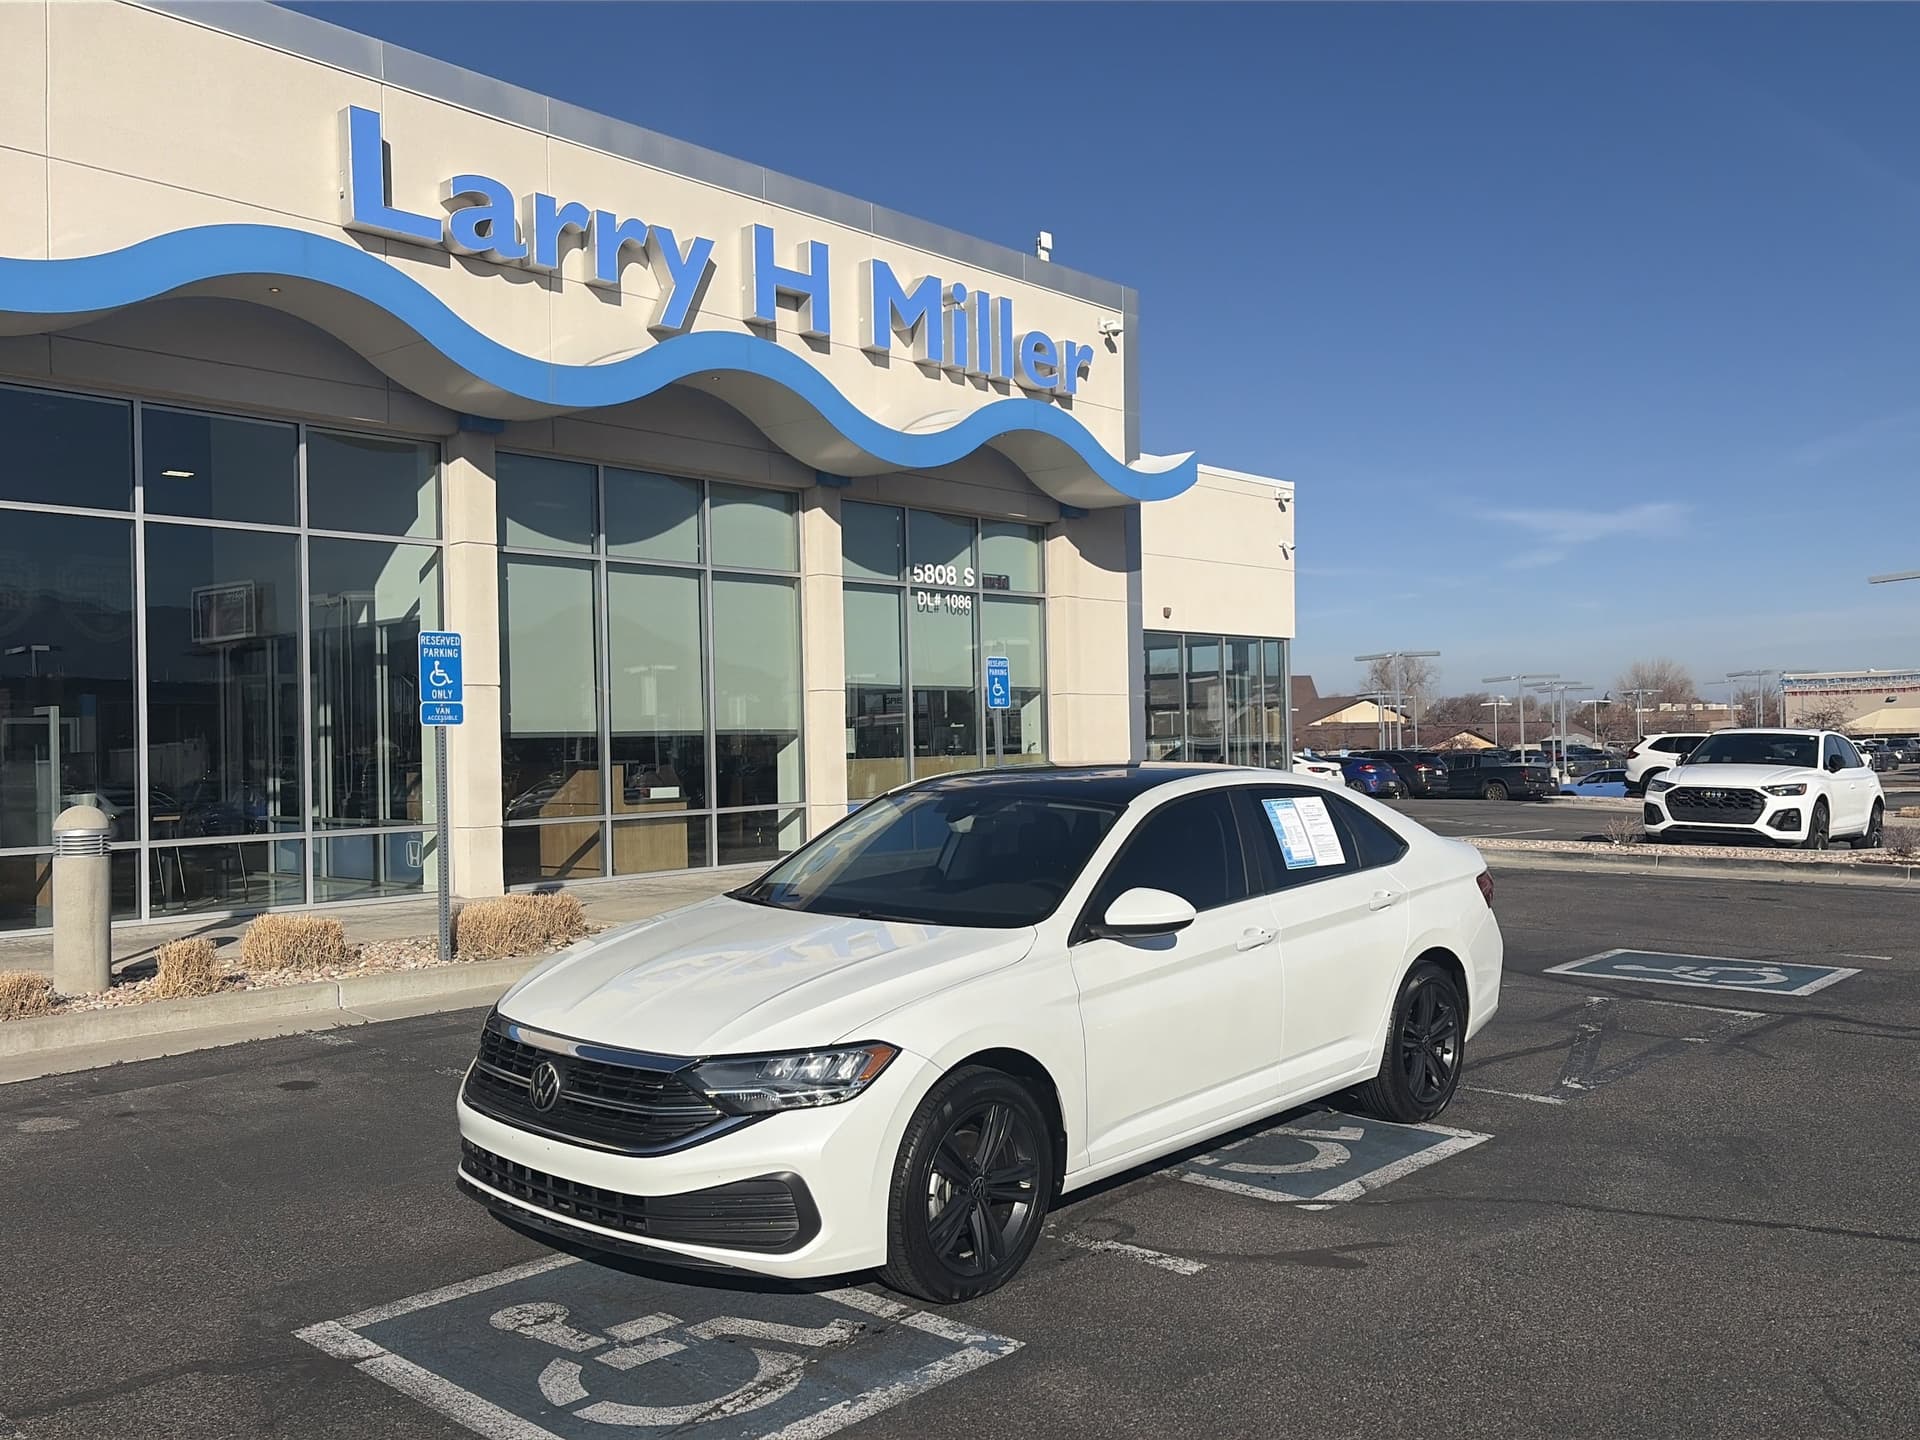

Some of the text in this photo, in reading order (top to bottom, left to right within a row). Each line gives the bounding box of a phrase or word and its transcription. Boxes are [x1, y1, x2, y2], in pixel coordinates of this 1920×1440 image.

[340, 104, 1095, 396] Larry H Miller
[913, 563, 975, 587] 5808 S
[917, 591, 972, 609] DL# 1086
[420, 635, 460, 646] RESERVED
[423, 647, 459, 658] PARKING
[431, 689, 453, 699] ONLY
